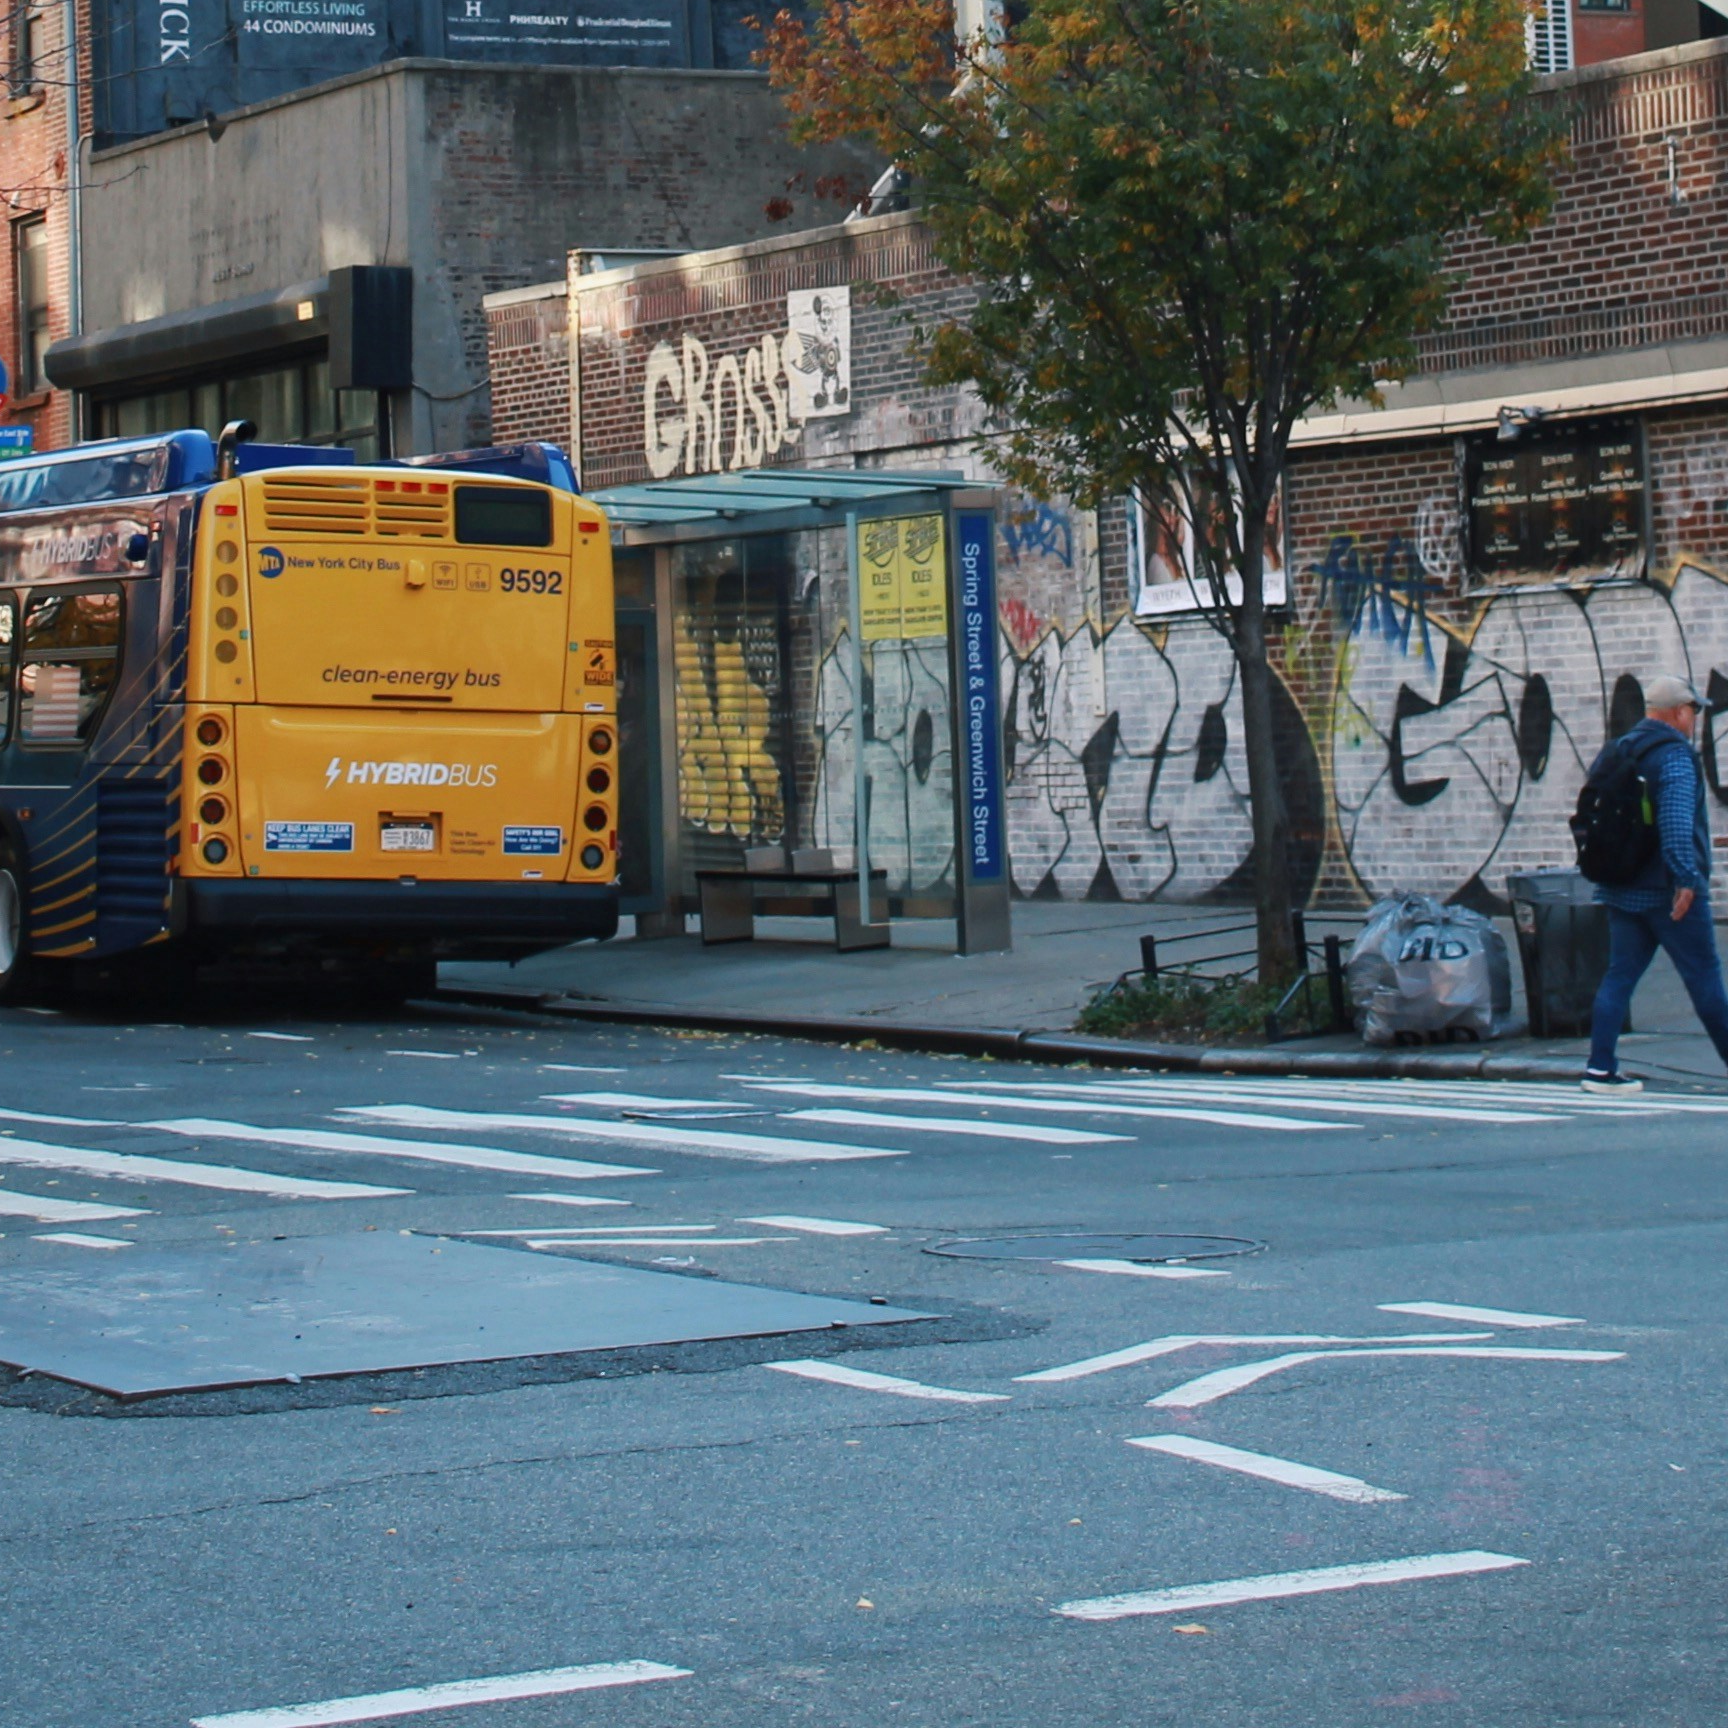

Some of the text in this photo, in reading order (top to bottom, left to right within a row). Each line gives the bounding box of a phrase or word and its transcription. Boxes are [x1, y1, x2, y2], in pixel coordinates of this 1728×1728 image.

[243, 1, 365, 16] EFFORTLESS LIVING
[243, 20, 375, 36] 44 CONDOMINIUMS
[288, 556, 401, 572] New York City Bus
[500, 568, 563, 594] 9592
[322, 665, 501, 689] clean-energy bus
[961, 541, 990, 865] Spring Street & Greenwich Street
[347, 761, 498, 787] HYBRIDBUS
